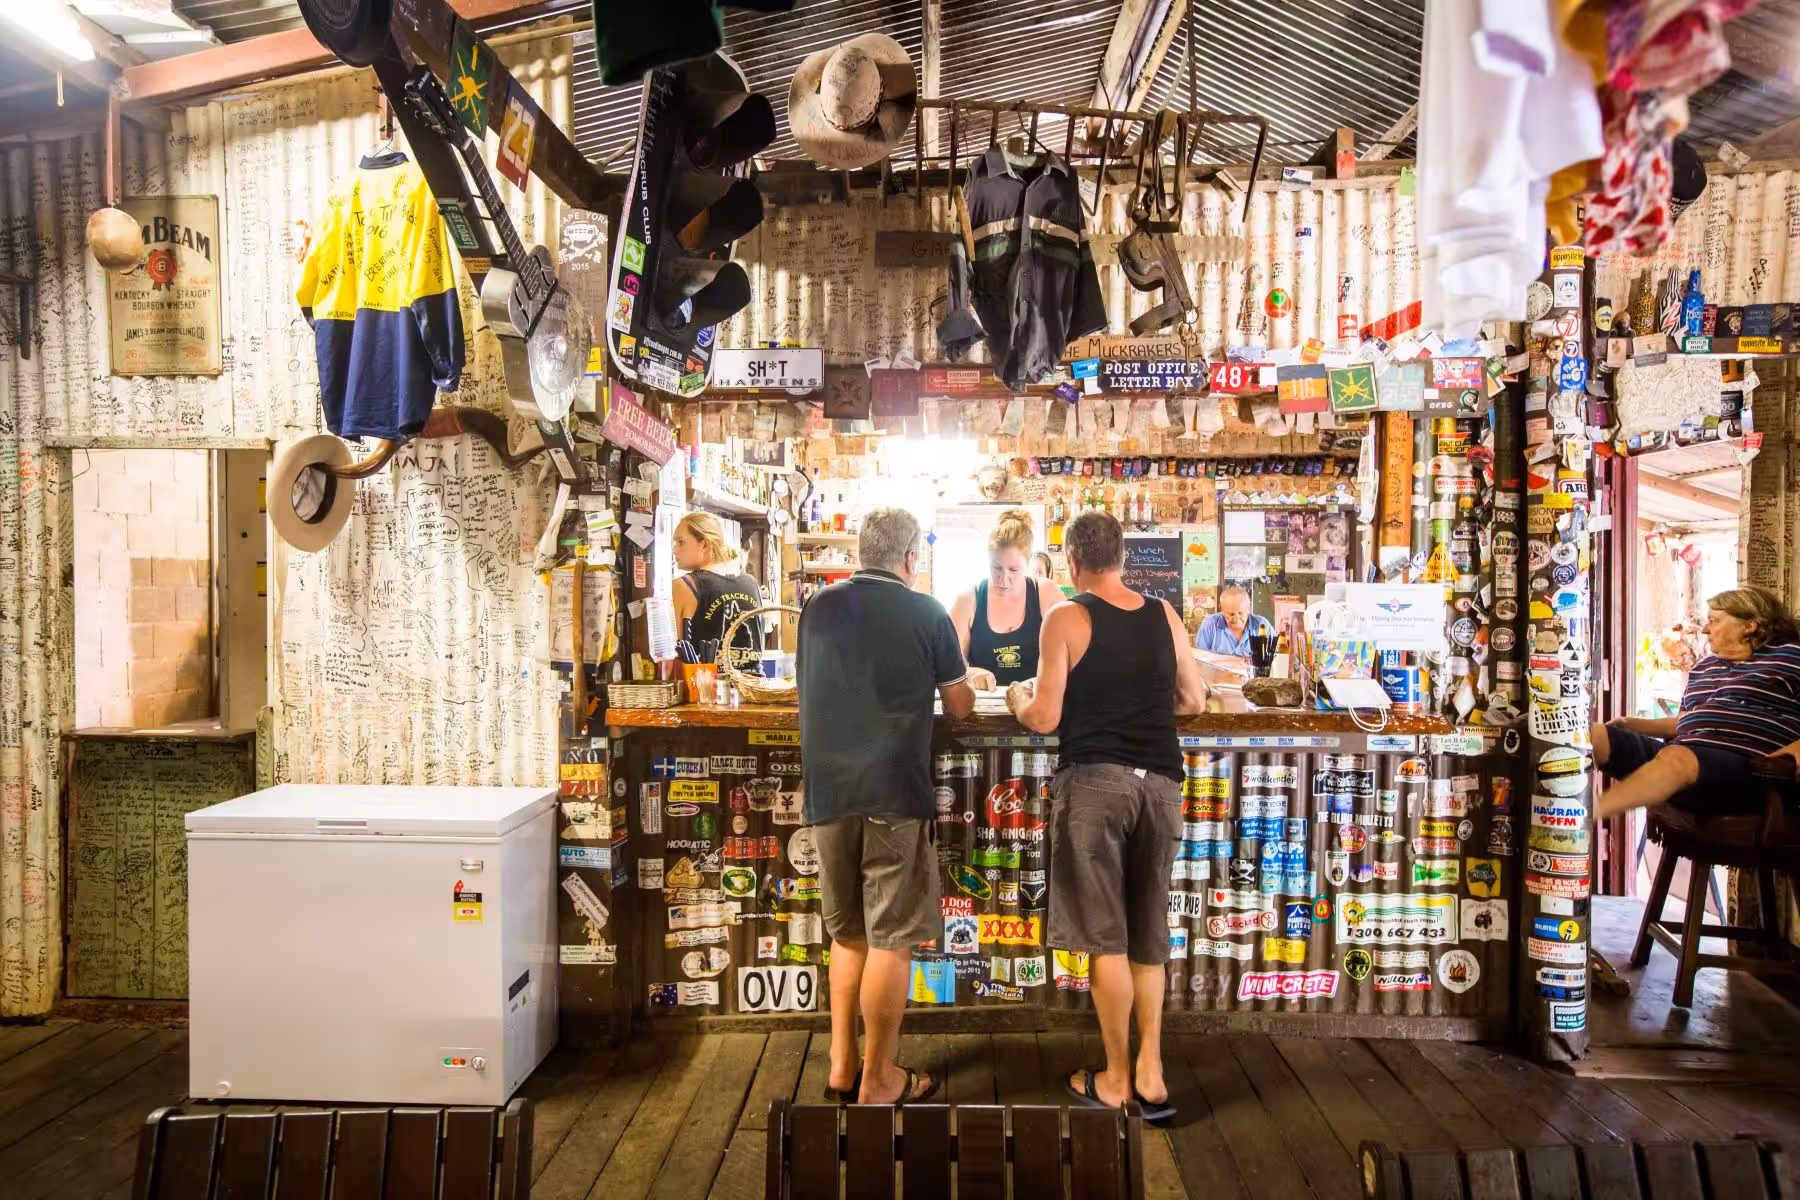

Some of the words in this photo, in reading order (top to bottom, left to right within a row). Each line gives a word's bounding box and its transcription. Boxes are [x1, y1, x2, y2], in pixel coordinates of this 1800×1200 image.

[639, 149, 648, 201] SCRUB
[559, 211, 581, 228] CAPE
[585, 211, 609, 226] YORK
[642, 206, 651, 245] CLUB
[153, 216, 212, 263] BEAM
[158, 261, 168, 272] B
[571, 263, 590, 271] 2015
[115, 289, 150, 300] KENTUCKY
[176, 289, 212, 299] STRAIGHT
[132, 301, 165, 311] BOURBON
[167, 301, 196, 310] WHISKEY
[124, 327, 145, 342] JAMES
[149, 328, 165, 336] BEAM
[1064, 345, 1080, 359] HE
[1088, 338, 1182, 358] MUCKRAKERS
[1741, 338, 1765, 349] opposite
[1104, 362, 1140, 375] POST
[718, 378, 818, 386] HAPPENS
[1110, 376, 1161, 389] LETTER
[616, 397, 645, 432] FREE
[645, 418, 673, 451] BEER
[1138, 546, 1165, 556] lunch
[704, 599, 722, 621] MAKE
[720, 593, 749, 602] TRACKS
[749, 597, 758, 608] TO
[1242, 775, 1249, 783] 7
[1251, 773, 1297, 784] weekender
[1533, 805, 1585, 817] HAURAKI
[1540, 815, 1577, 826] 99FM
[1278, 841, 1304, 852] GPS
[949, 897, 971, 908] DOG
[1183, 893, 1200, 917] PUB
[983, 920, 1035, 939] XXXX
[1347, 927, 1383, 938] 1300
[1387, 927, 1414, 938] 667
[1419, 927, 1446, 938] 433
[949, 958, 962, 967] Trip
[970, 958, 980, 966] the
[981, 959, 991, 968] Tip
[967, 967, 981, 975] 2012
[1378, 976, 1414, 984] NULON
[743, 970, 786, 1009] OV
[796, 970, 813, 1009] 9
[1243, 974, 1335, 998] MINI-CRETE
